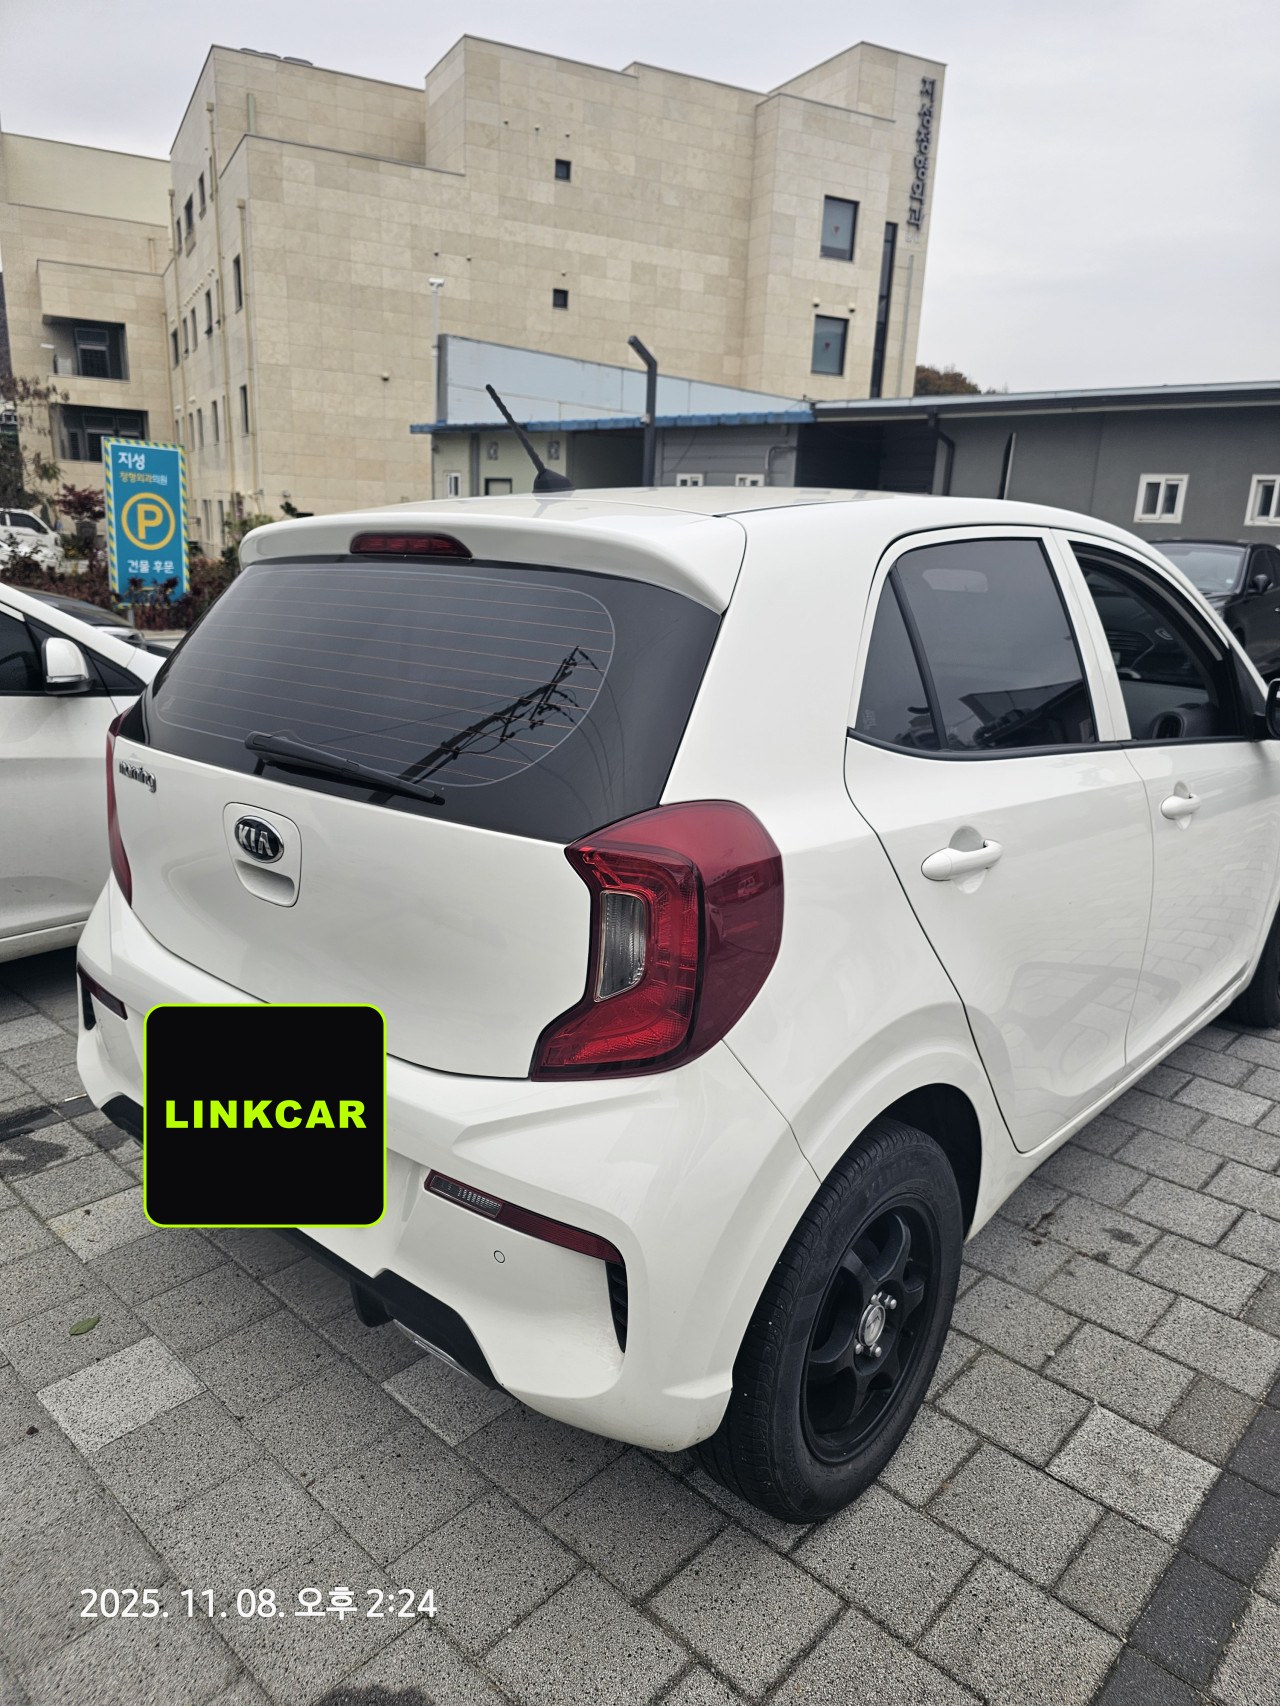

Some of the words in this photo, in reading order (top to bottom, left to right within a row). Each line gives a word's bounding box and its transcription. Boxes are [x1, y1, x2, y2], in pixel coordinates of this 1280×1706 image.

[118, 452, 146, 471] 지성
[119, 471, 168, 486] 정형외과의원
[137, 503, 164, 540] P
[127, 560, 150, 574] 건물
[153, 560, 175, 574] 후문
[238, 823, 274, 857] KIA
